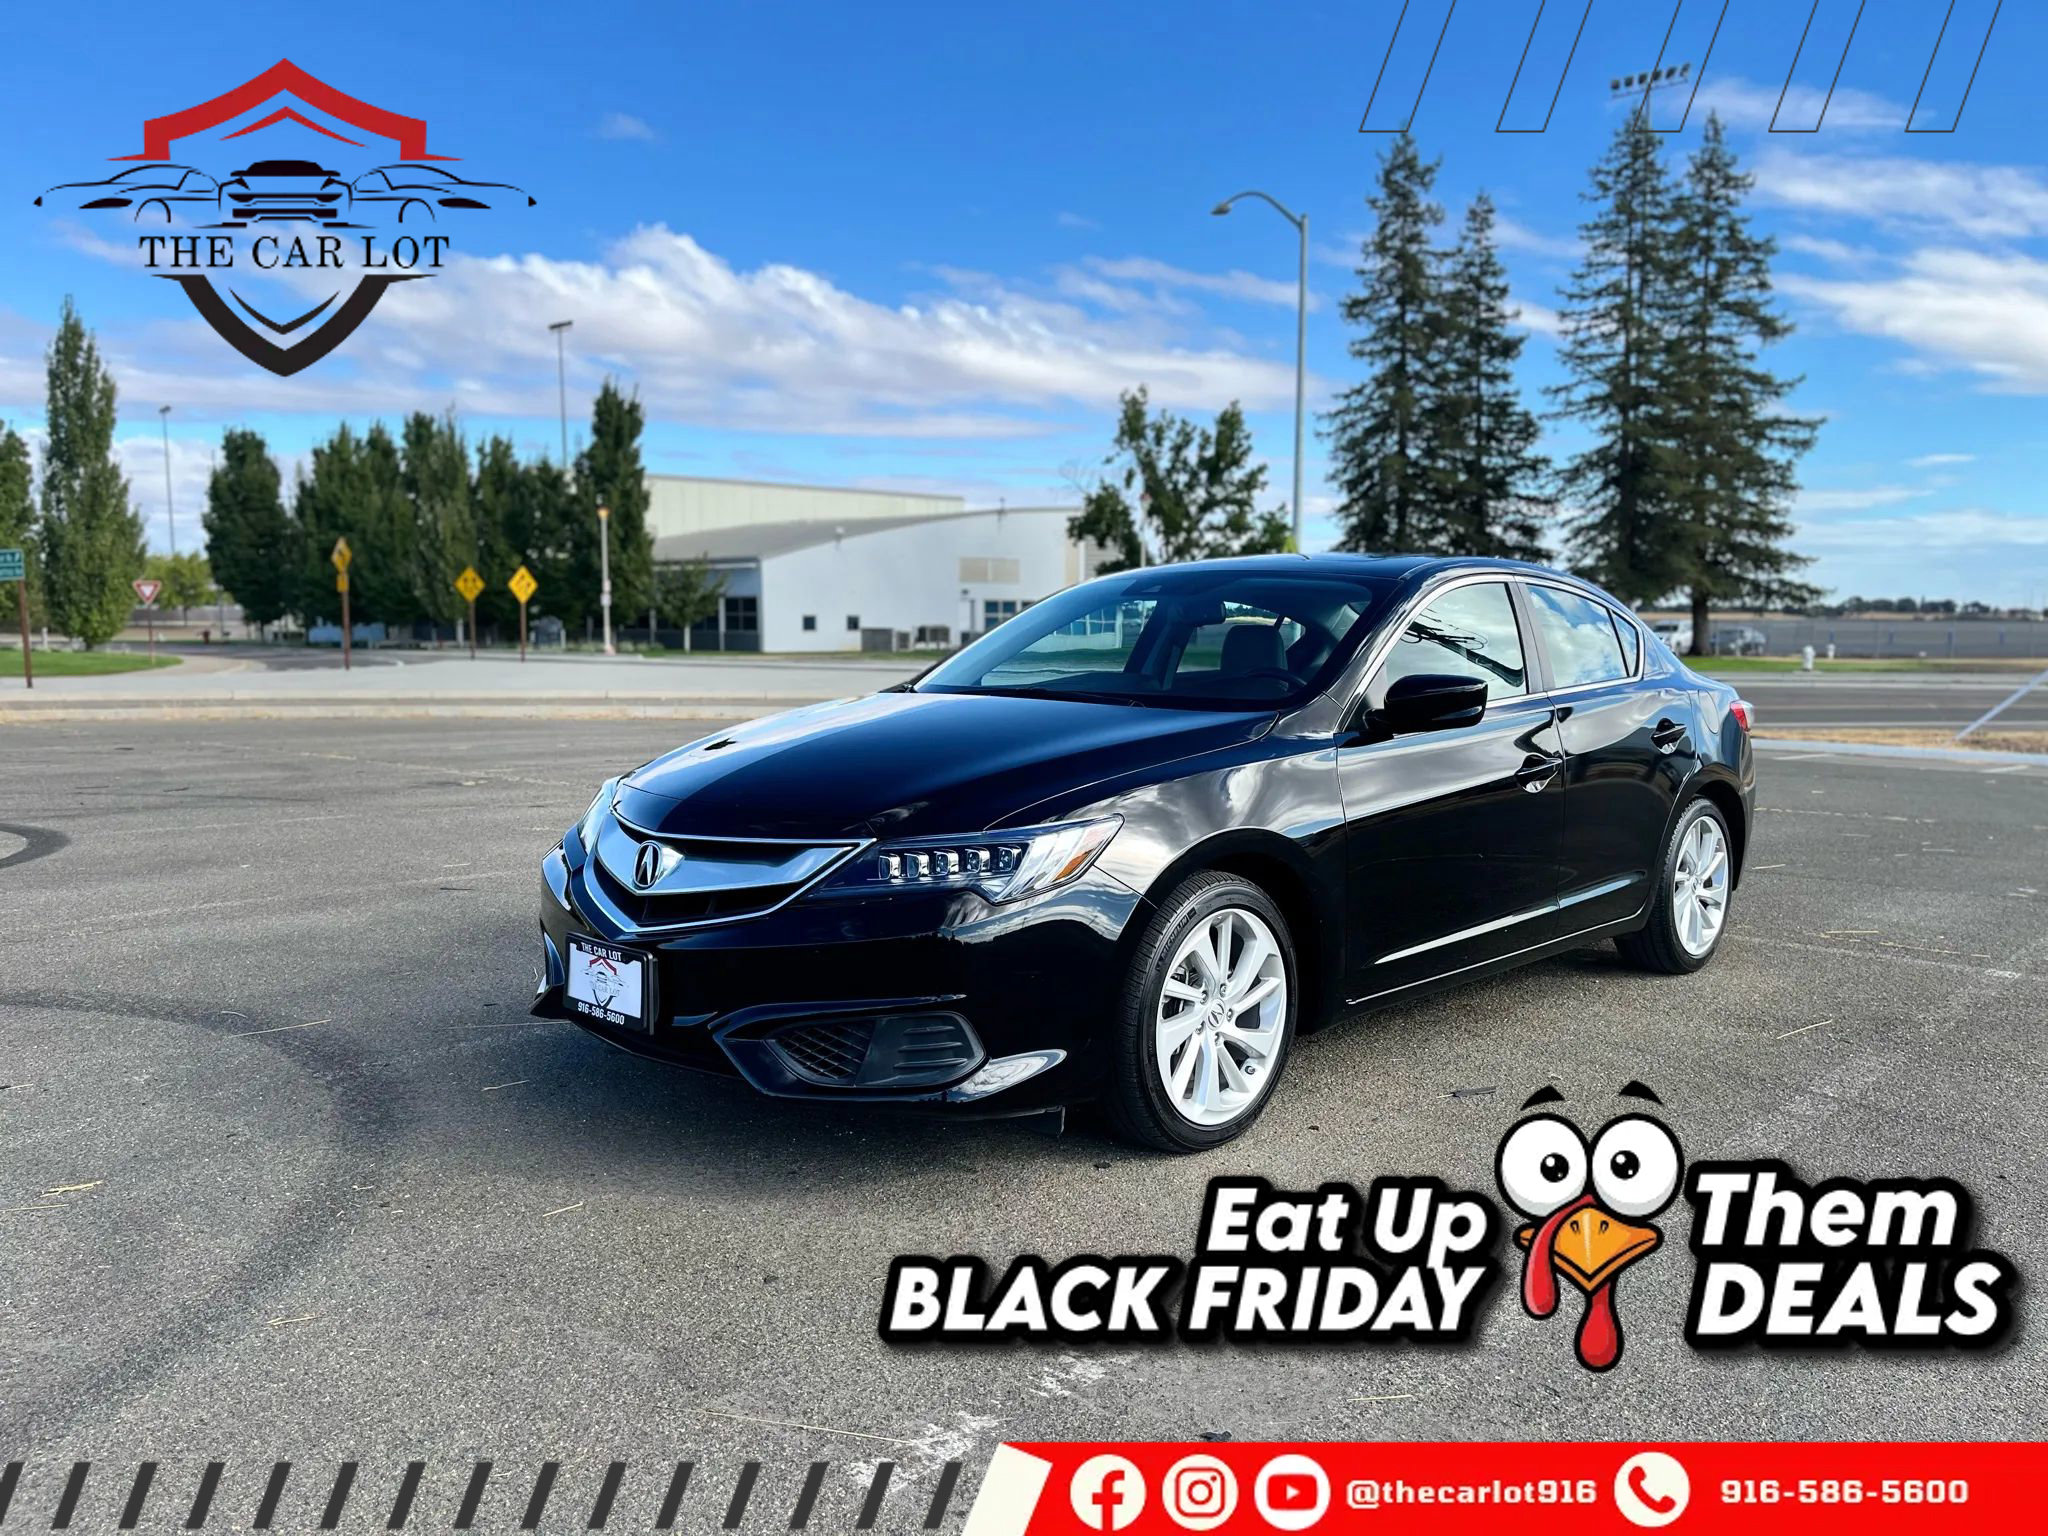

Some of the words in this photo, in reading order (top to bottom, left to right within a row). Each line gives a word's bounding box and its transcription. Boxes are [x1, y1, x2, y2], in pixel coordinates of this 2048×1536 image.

[581, 942, 592, 954] THE
[594, 946, 607, 958] CAR
[608, 950, 622, 961] LOT
[577, 1001, 625, 1025] 916-586-5600
